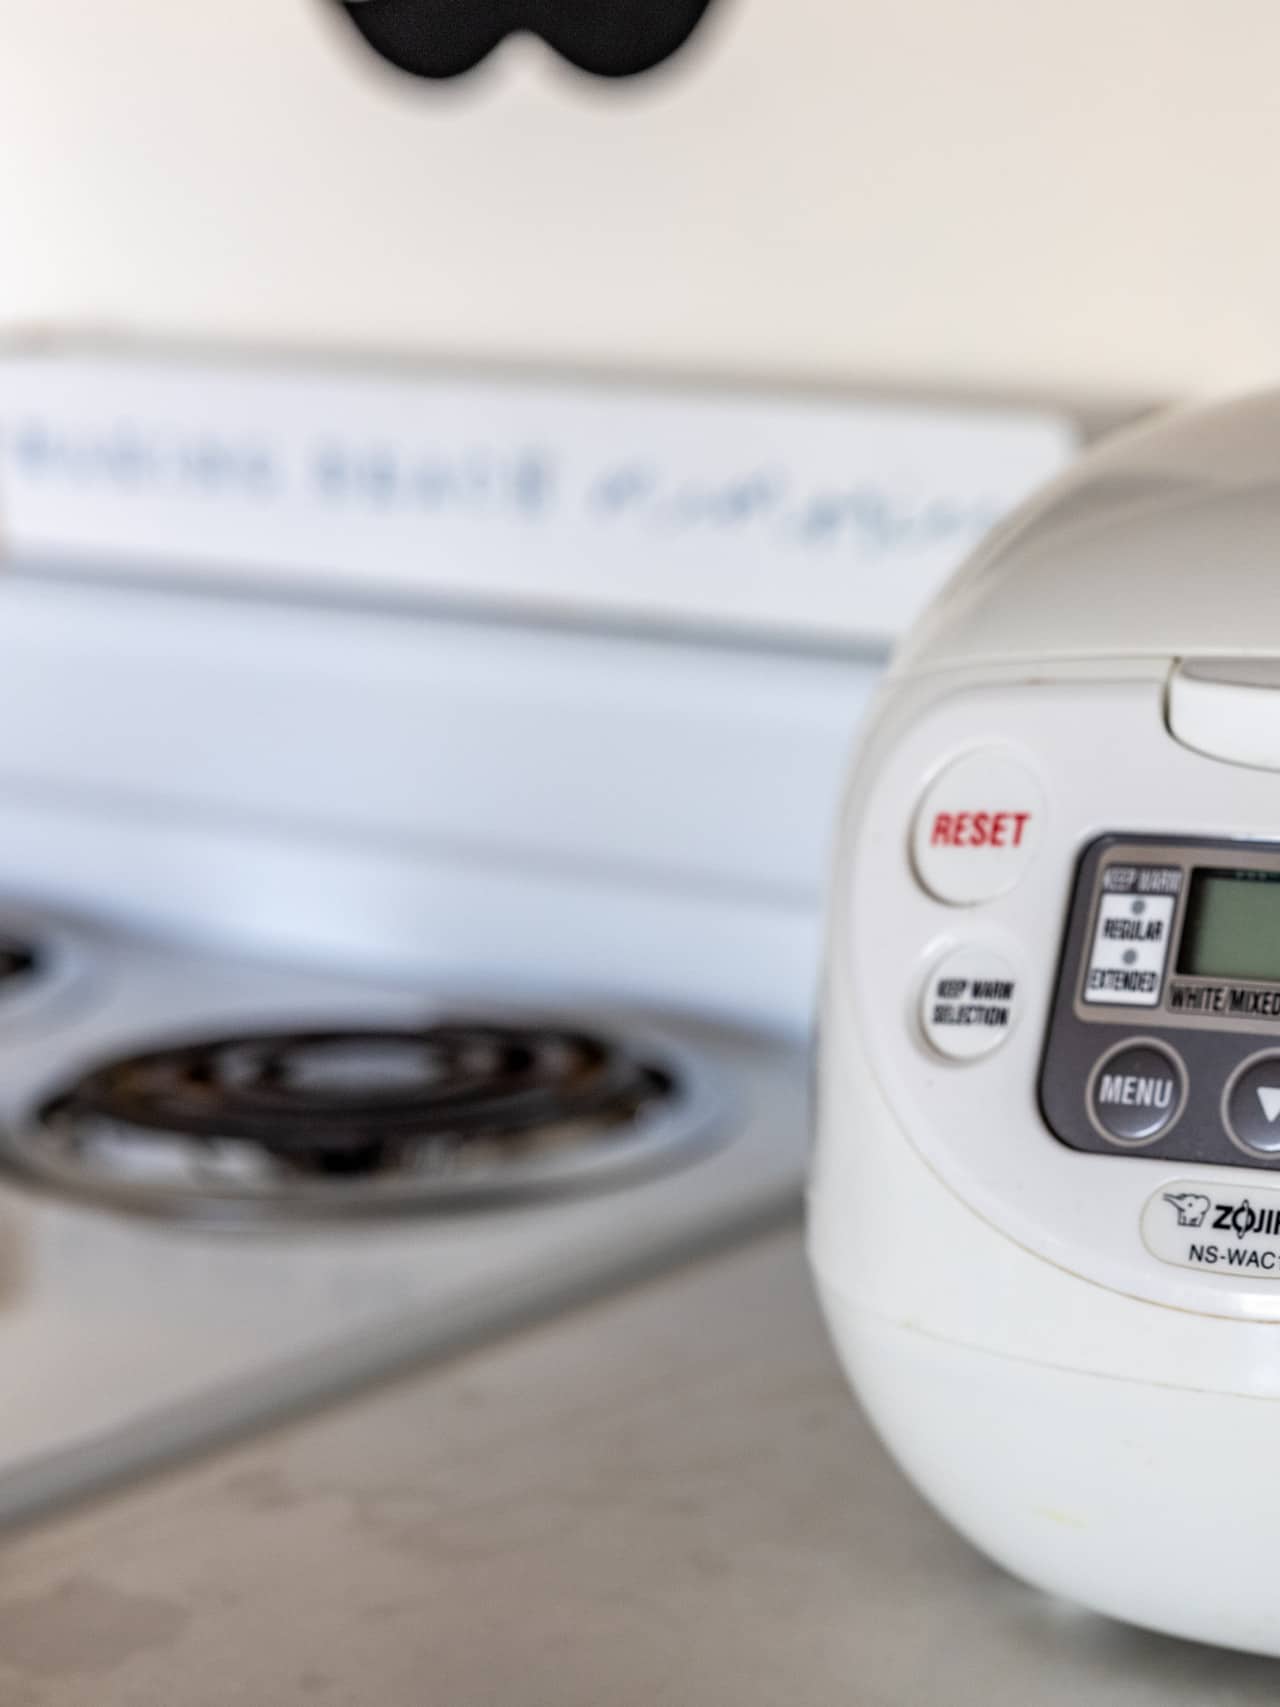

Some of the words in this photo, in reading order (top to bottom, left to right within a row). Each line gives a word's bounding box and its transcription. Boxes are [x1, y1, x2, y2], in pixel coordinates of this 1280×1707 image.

[930, 812, 1030, 847] RESET
[1103, 868, 1137, 889] KEEP
[1138, 868, 1182, 892] WARM
[1103, 918, 1163, 941] REGULAR
[938, 979, 967, 998] KEEP
[972, 979, 1014, 999] WARM
[1089, 968, 1157, 993] EXTENDED
[933, 1004, 1009, 1025] SELECTION
[1100, 1075, 1173, 1108] MENU
